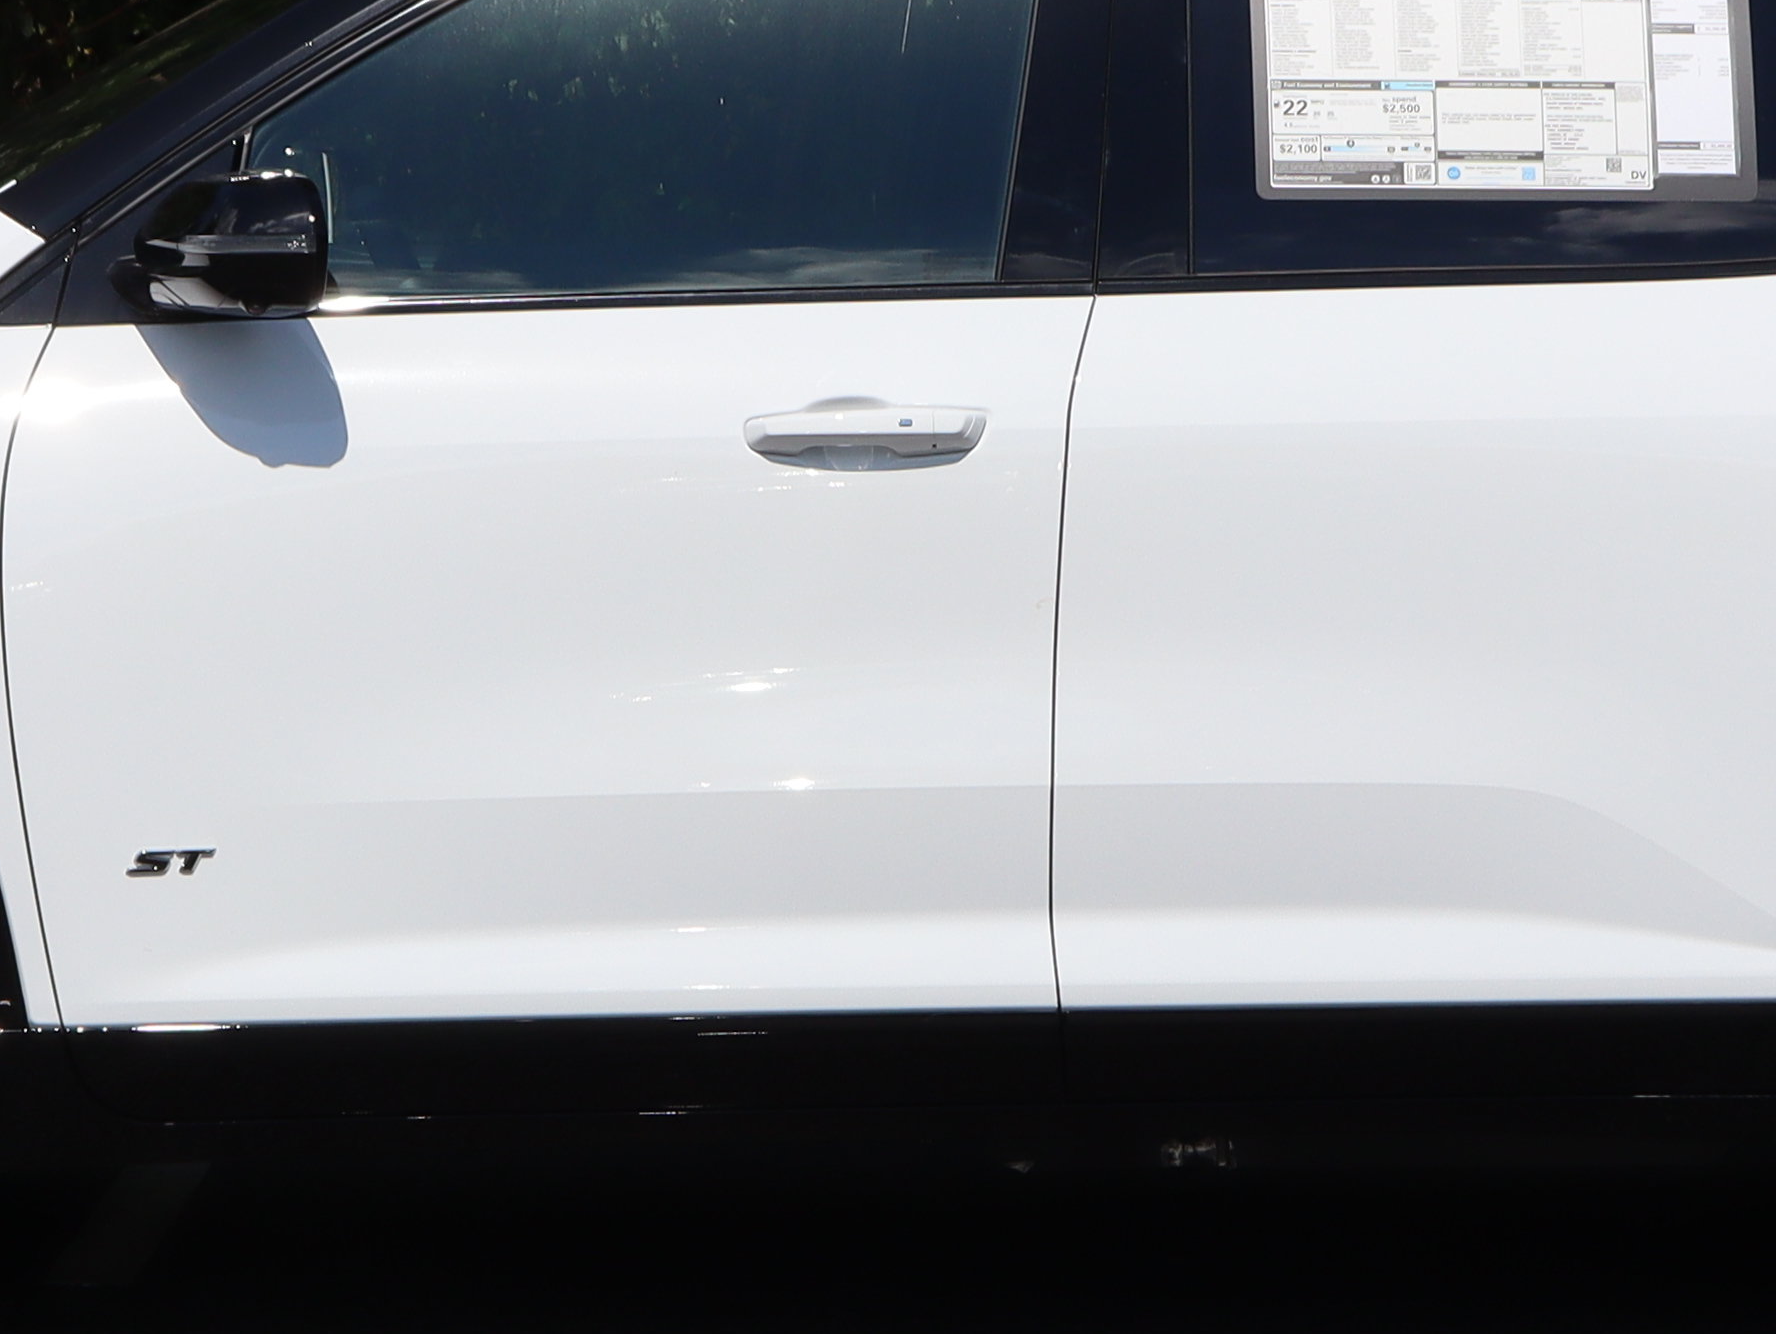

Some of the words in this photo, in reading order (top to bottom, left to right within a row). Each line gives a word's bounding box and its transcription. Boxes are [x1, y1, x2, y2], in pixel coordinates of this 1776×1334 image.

[1392, 96, 1417, 104] spend
[1283, 99, 1308, 116] 22
[1382, 103, 1421, 115] $2,500
[1279, 144, 1318, 155] $2,100
[1630, 170, 1647, 180] DV
[125, 845, 217, 878] ST
